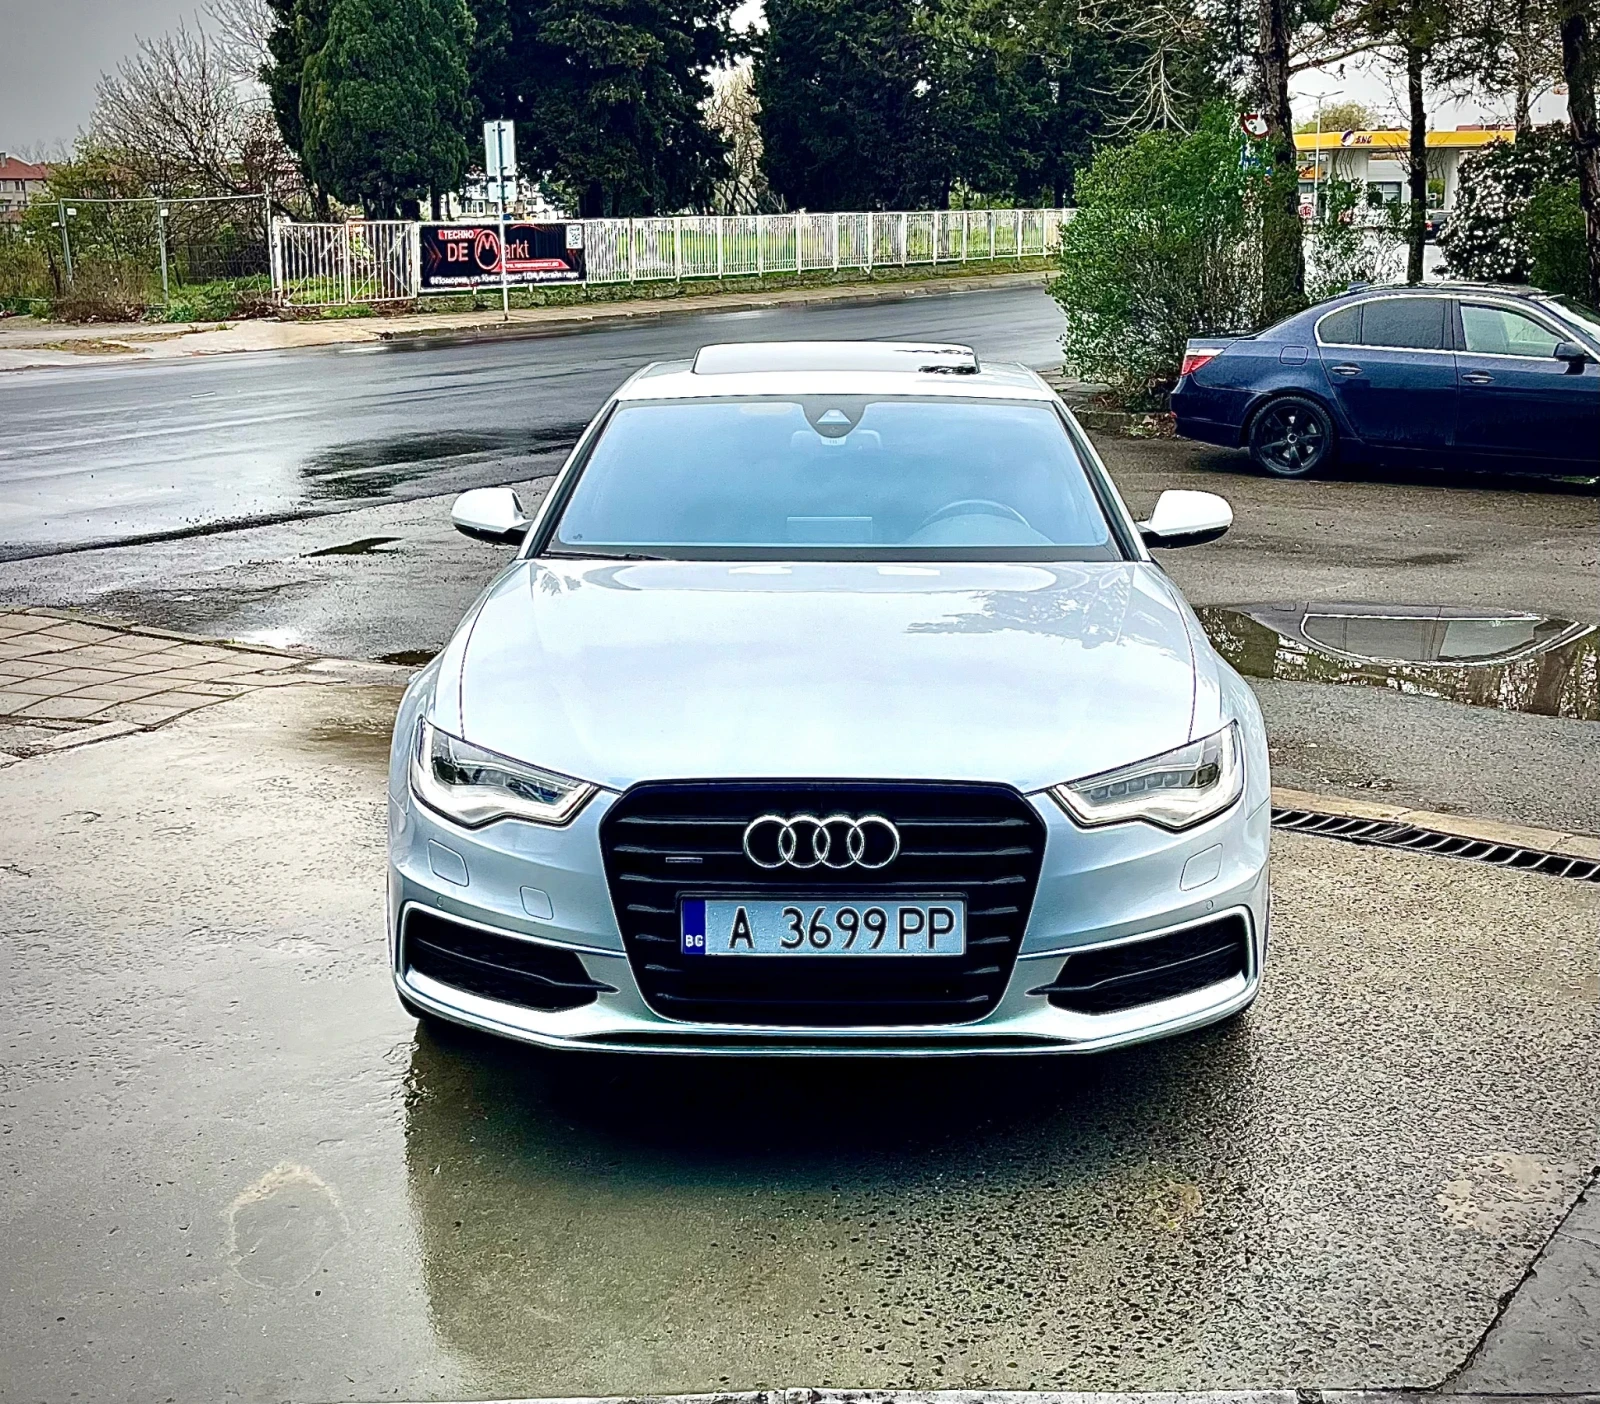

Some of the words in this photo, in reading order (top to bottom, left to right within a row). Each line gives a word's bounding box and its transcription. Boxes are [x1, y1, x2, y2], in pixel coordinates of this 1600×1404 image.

[443, 230, 475, 240] TECHNO
[447, 242, 469, 262] DE
[729, 906, 755, 949] A
[780, 906, 888, 949] 3699
[898, 906, 956, 949] PP
[685, 934, 704, 947] BG
